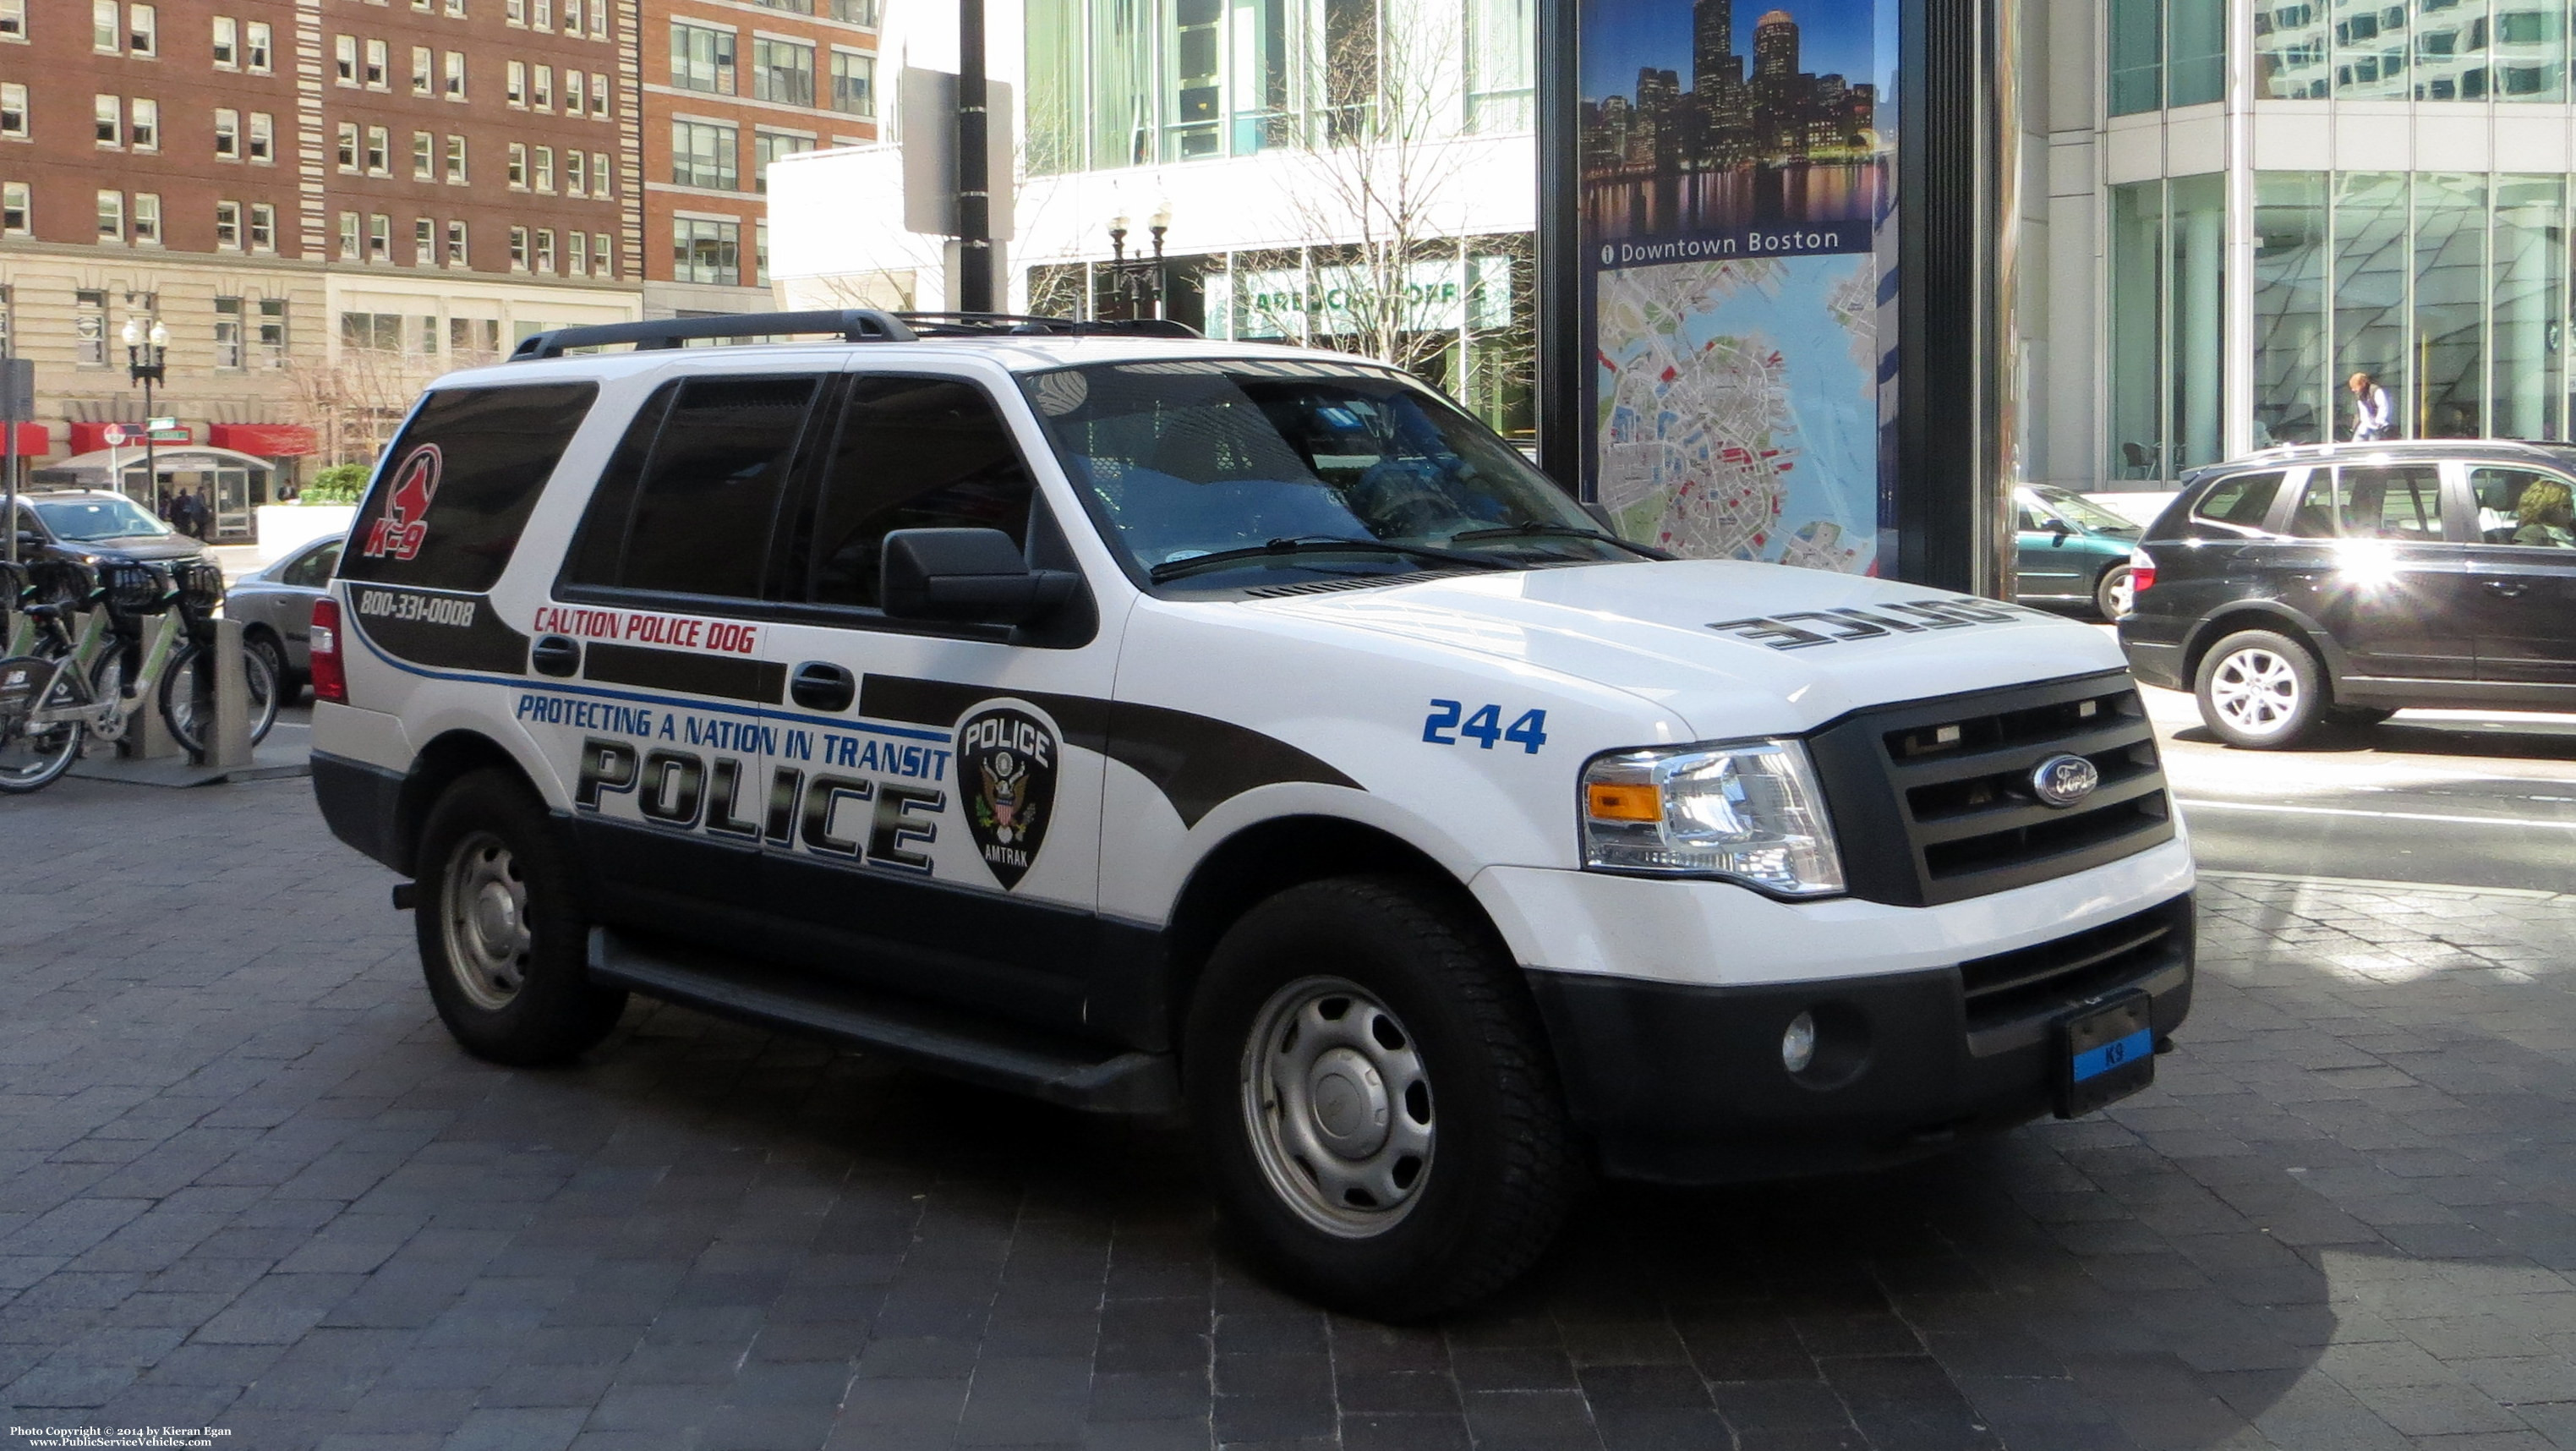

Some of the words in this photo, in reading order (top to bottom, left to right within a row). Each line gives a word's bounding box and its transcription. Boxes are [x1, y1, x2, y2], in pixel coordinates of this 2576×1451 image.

[1622, 238, 1736, 261] Downtown
[1748, 231, 1839, 252] Boston
[363, 517, 428, 561] K-9
[360, 590, 476, 627] 800-331-0008
[533, 606, 623, 638] CAUTION
[626, 614, 703, 647] POLICE
[706, 622, 757, 654] DOG
[517, 694, 652, 737] PROTECTING
[659, 713, 676, 742] A
[684, 716, 779, 757] NATION
[785, 729, 814, 761] IN
[823, 733, 952, 781] TRANSIT
[965, 718, 1051, 769] POLICE
[1422, 698, 1547, 755] 244
[2056, 761, 2095, 795] Ford
[575, 735, 947, 876] POLICE
[985, 844, 1028, 868] AMTRAK
[2105, 1042, 2125, 1067] K9
